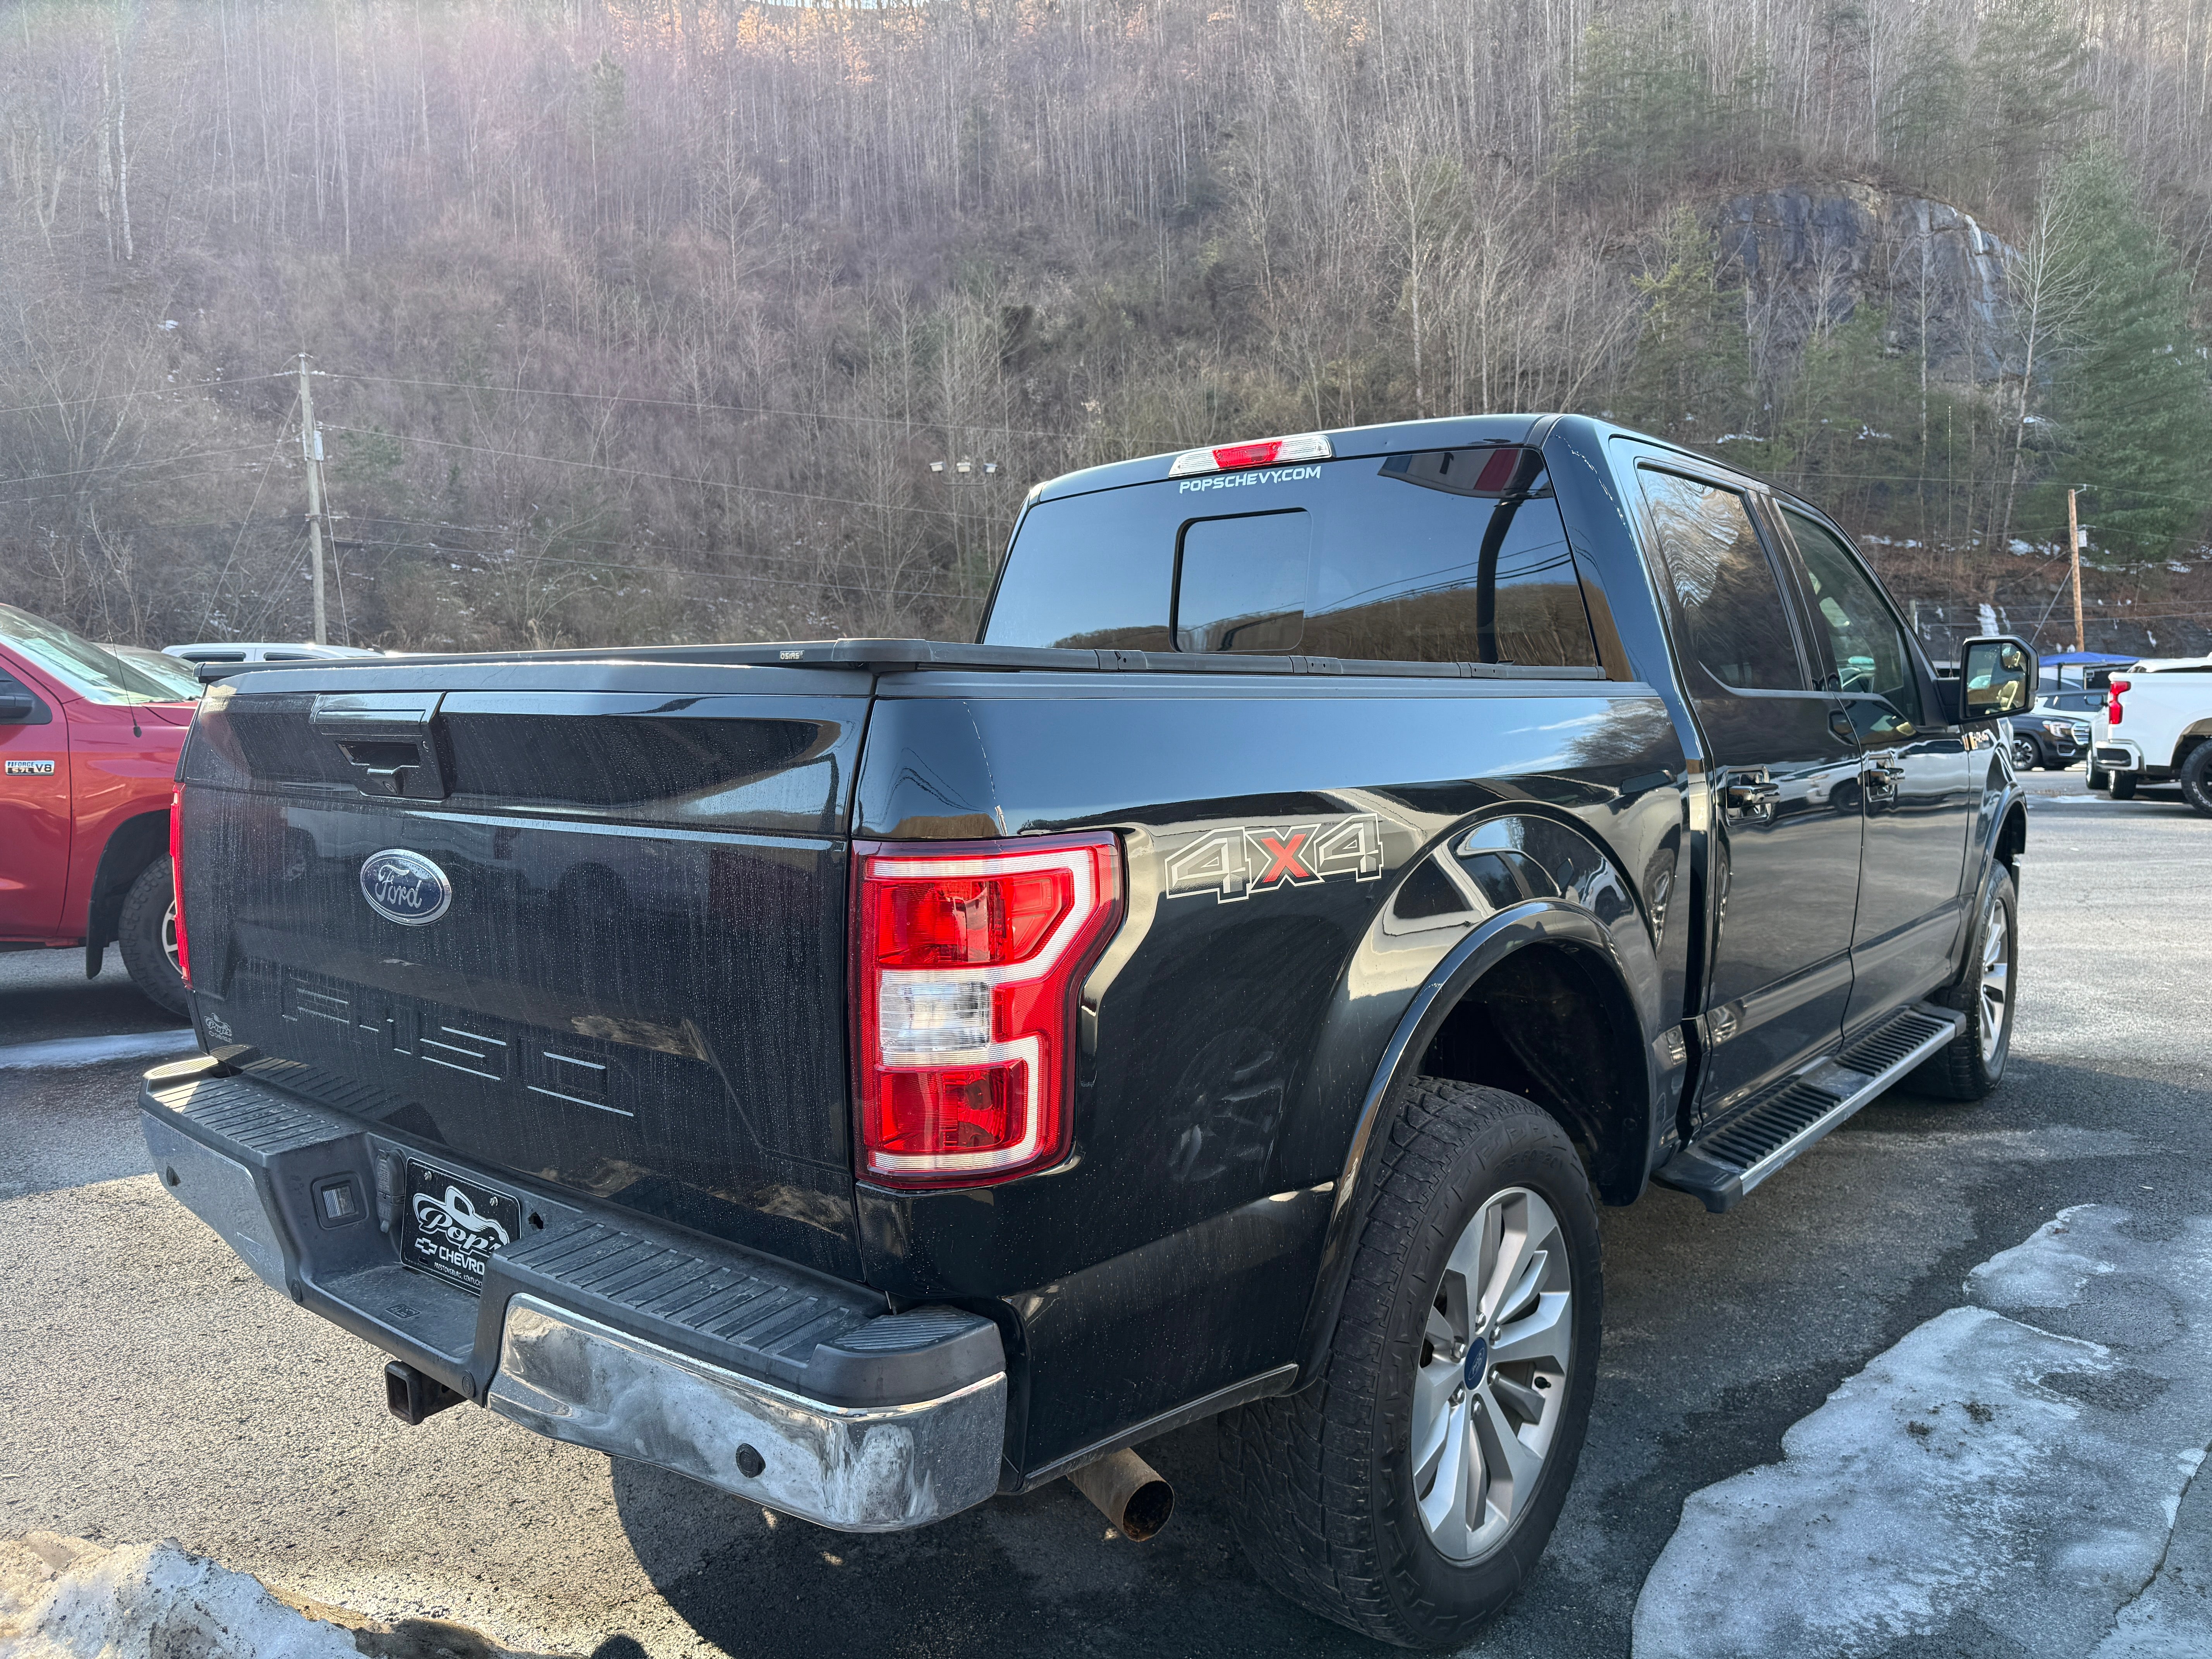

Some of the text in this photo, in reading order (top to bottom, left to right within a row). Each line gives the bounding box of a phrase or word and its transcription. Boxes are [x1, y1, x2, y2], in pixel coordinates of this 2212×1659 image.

[1179, 466, 1321, 494] POPSCHEVY.COM
[375, 864, 422, 908] Ford
[439, 1246, 485, 1275] CHEVRO
[464, 1274, 483, 1286] KENTUCK
